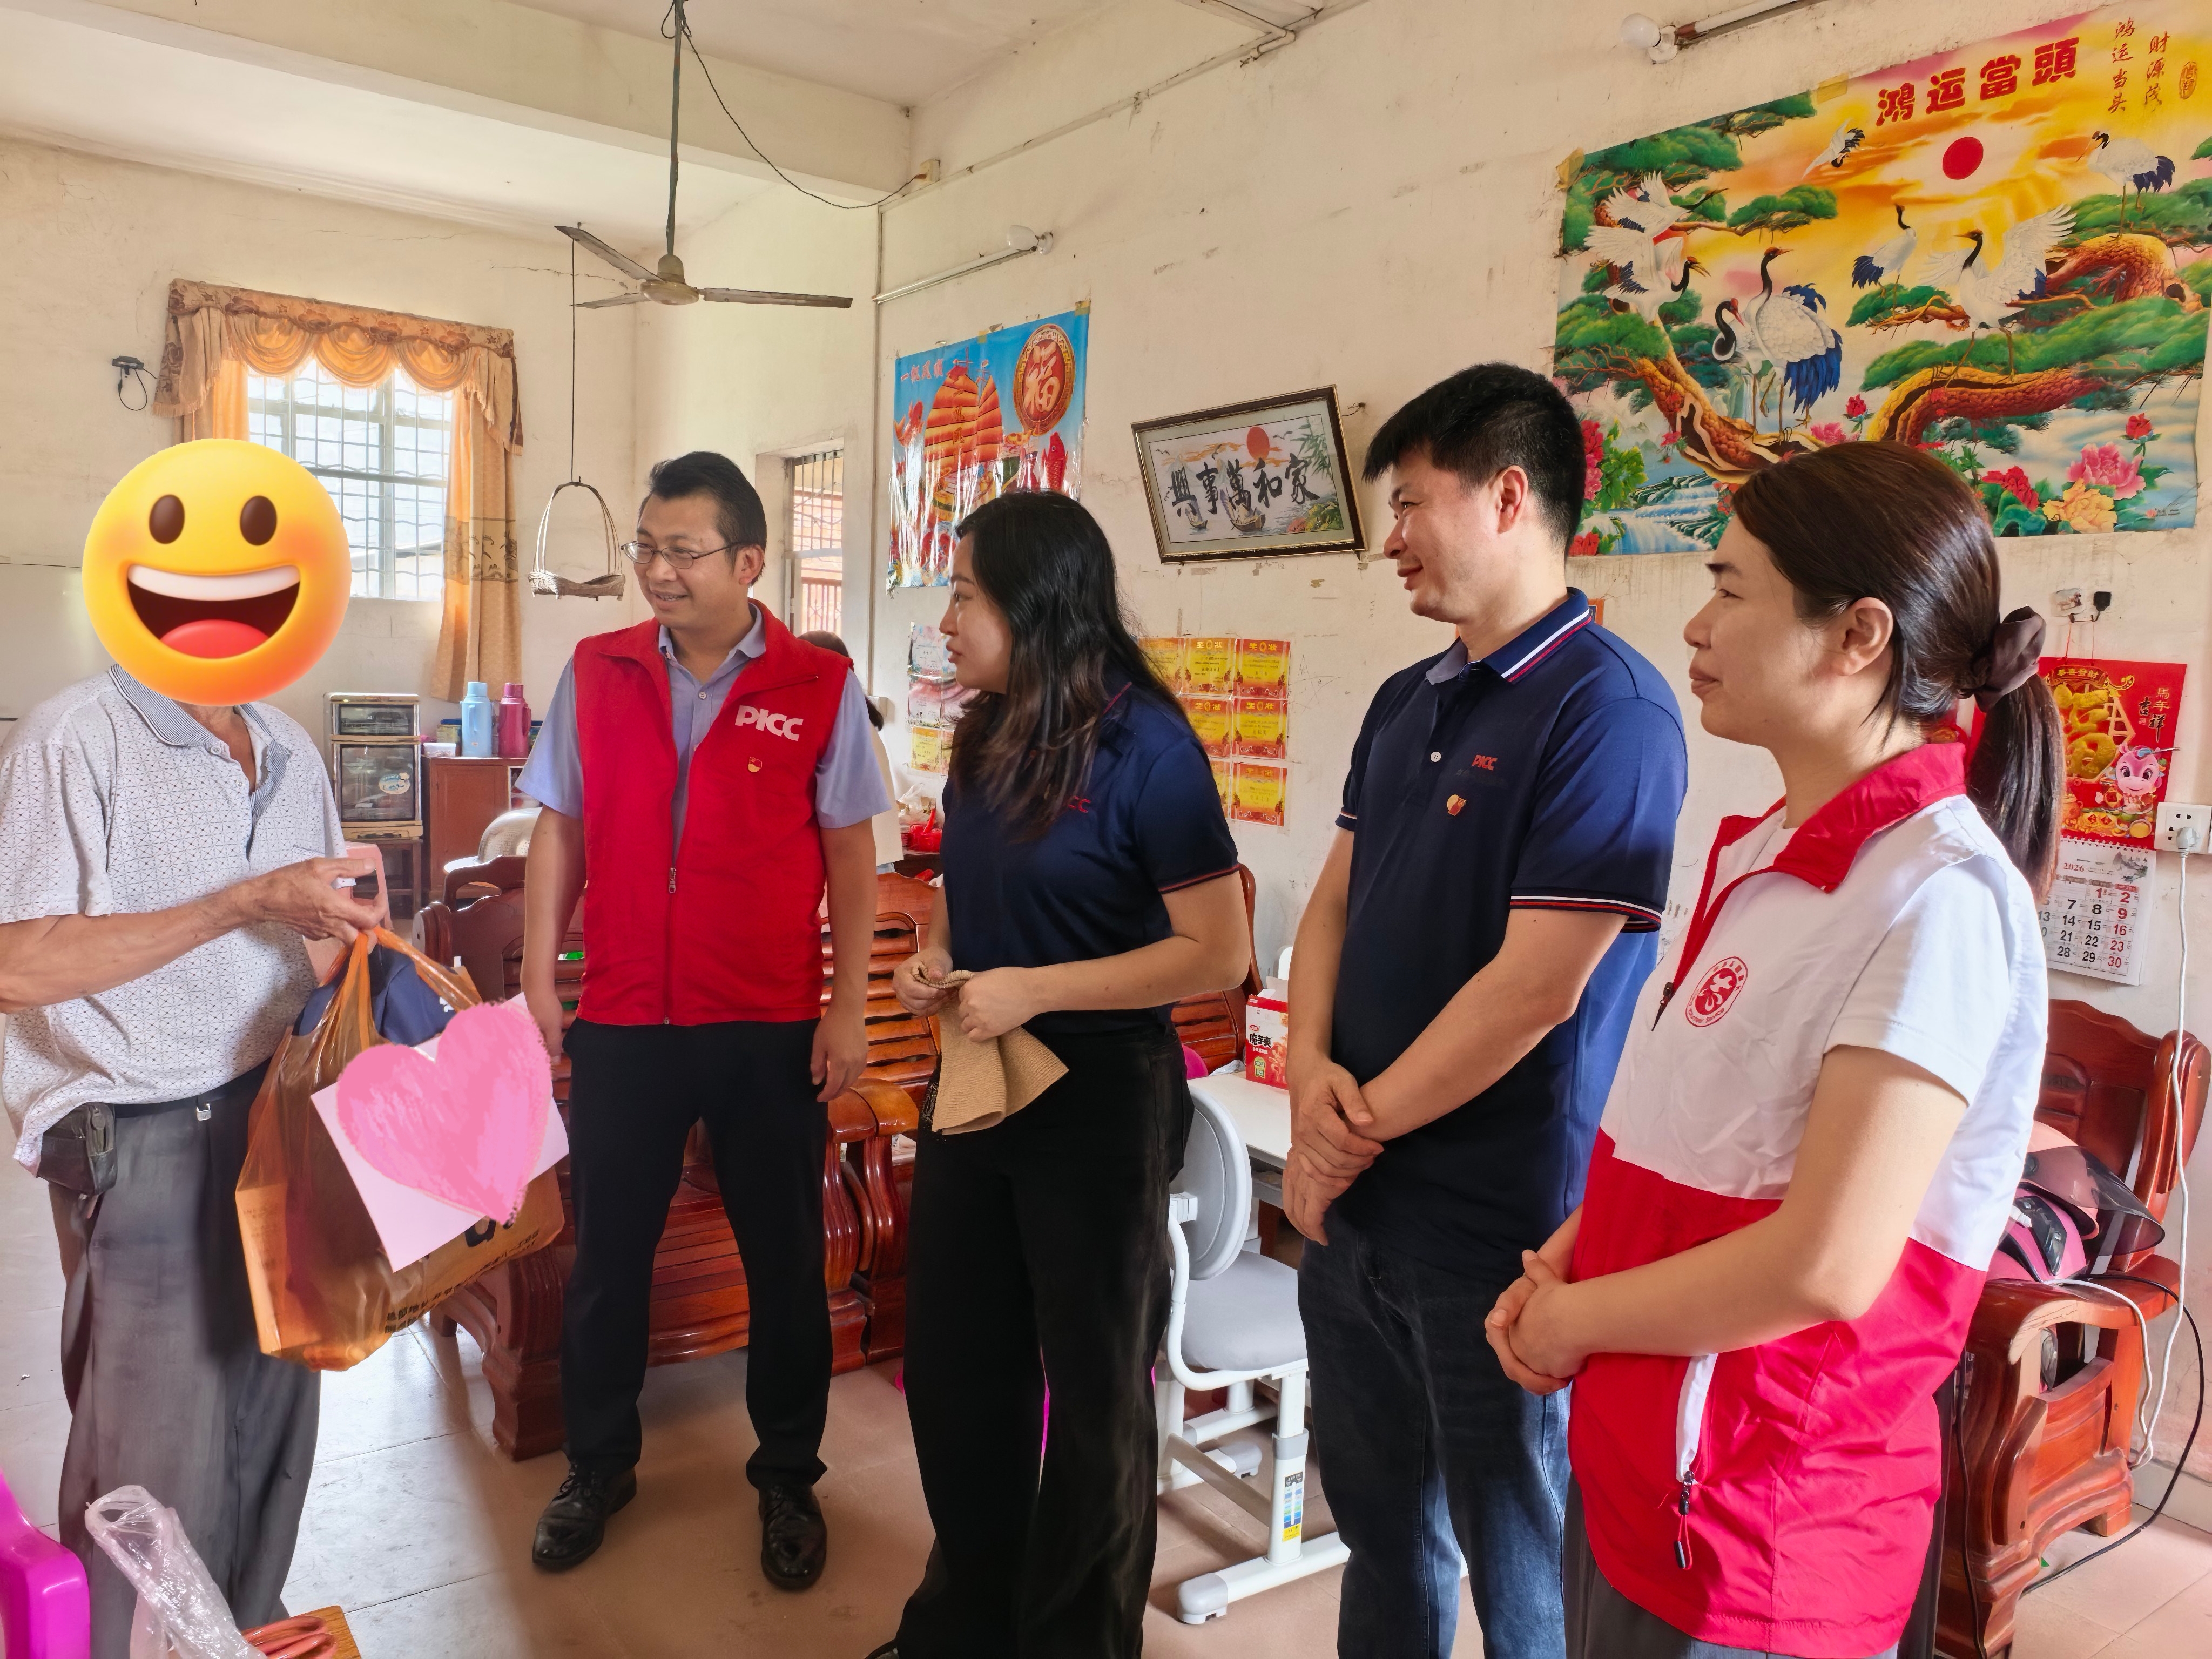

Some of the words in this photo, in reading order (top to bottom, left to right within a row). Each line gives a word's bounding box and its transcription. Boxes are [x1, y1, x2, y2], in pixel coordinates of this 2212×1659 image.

[1023, 341, 1060, 415] 福
[2153, 687, 2170, 712] 馬年
[734, 705, 804, 741] PICC
[1471, 754, 1498, 771] PICC
[2063, 862, 2085, 872] 2026
[2095, 888, 2102, 899] 1
[2120, 892, 2130, 903] 2
[2067, 899, 2076, 910] 7
[2092, 903, 2102, 915] 8
[2117, 908, 2128, 919] 9
[2038, 911, 2051, 922] 13
[2062, 914, 2075, 927] 14
[2088, 919, 2101, 931] 15
[2113, 923, 2127, 935] 16
[2060, 930, 2072, 942] 21
[2085, 935, 2099, 947] 22
[2110, 940, 2124, 952] 23
[2057, 946, 2071, 957] 28
[2082, 950, 2096, 963] 29
[2108, 956, 2122, 968] 30
[1249, 1033, 1272, 1048] 魔芋爽
